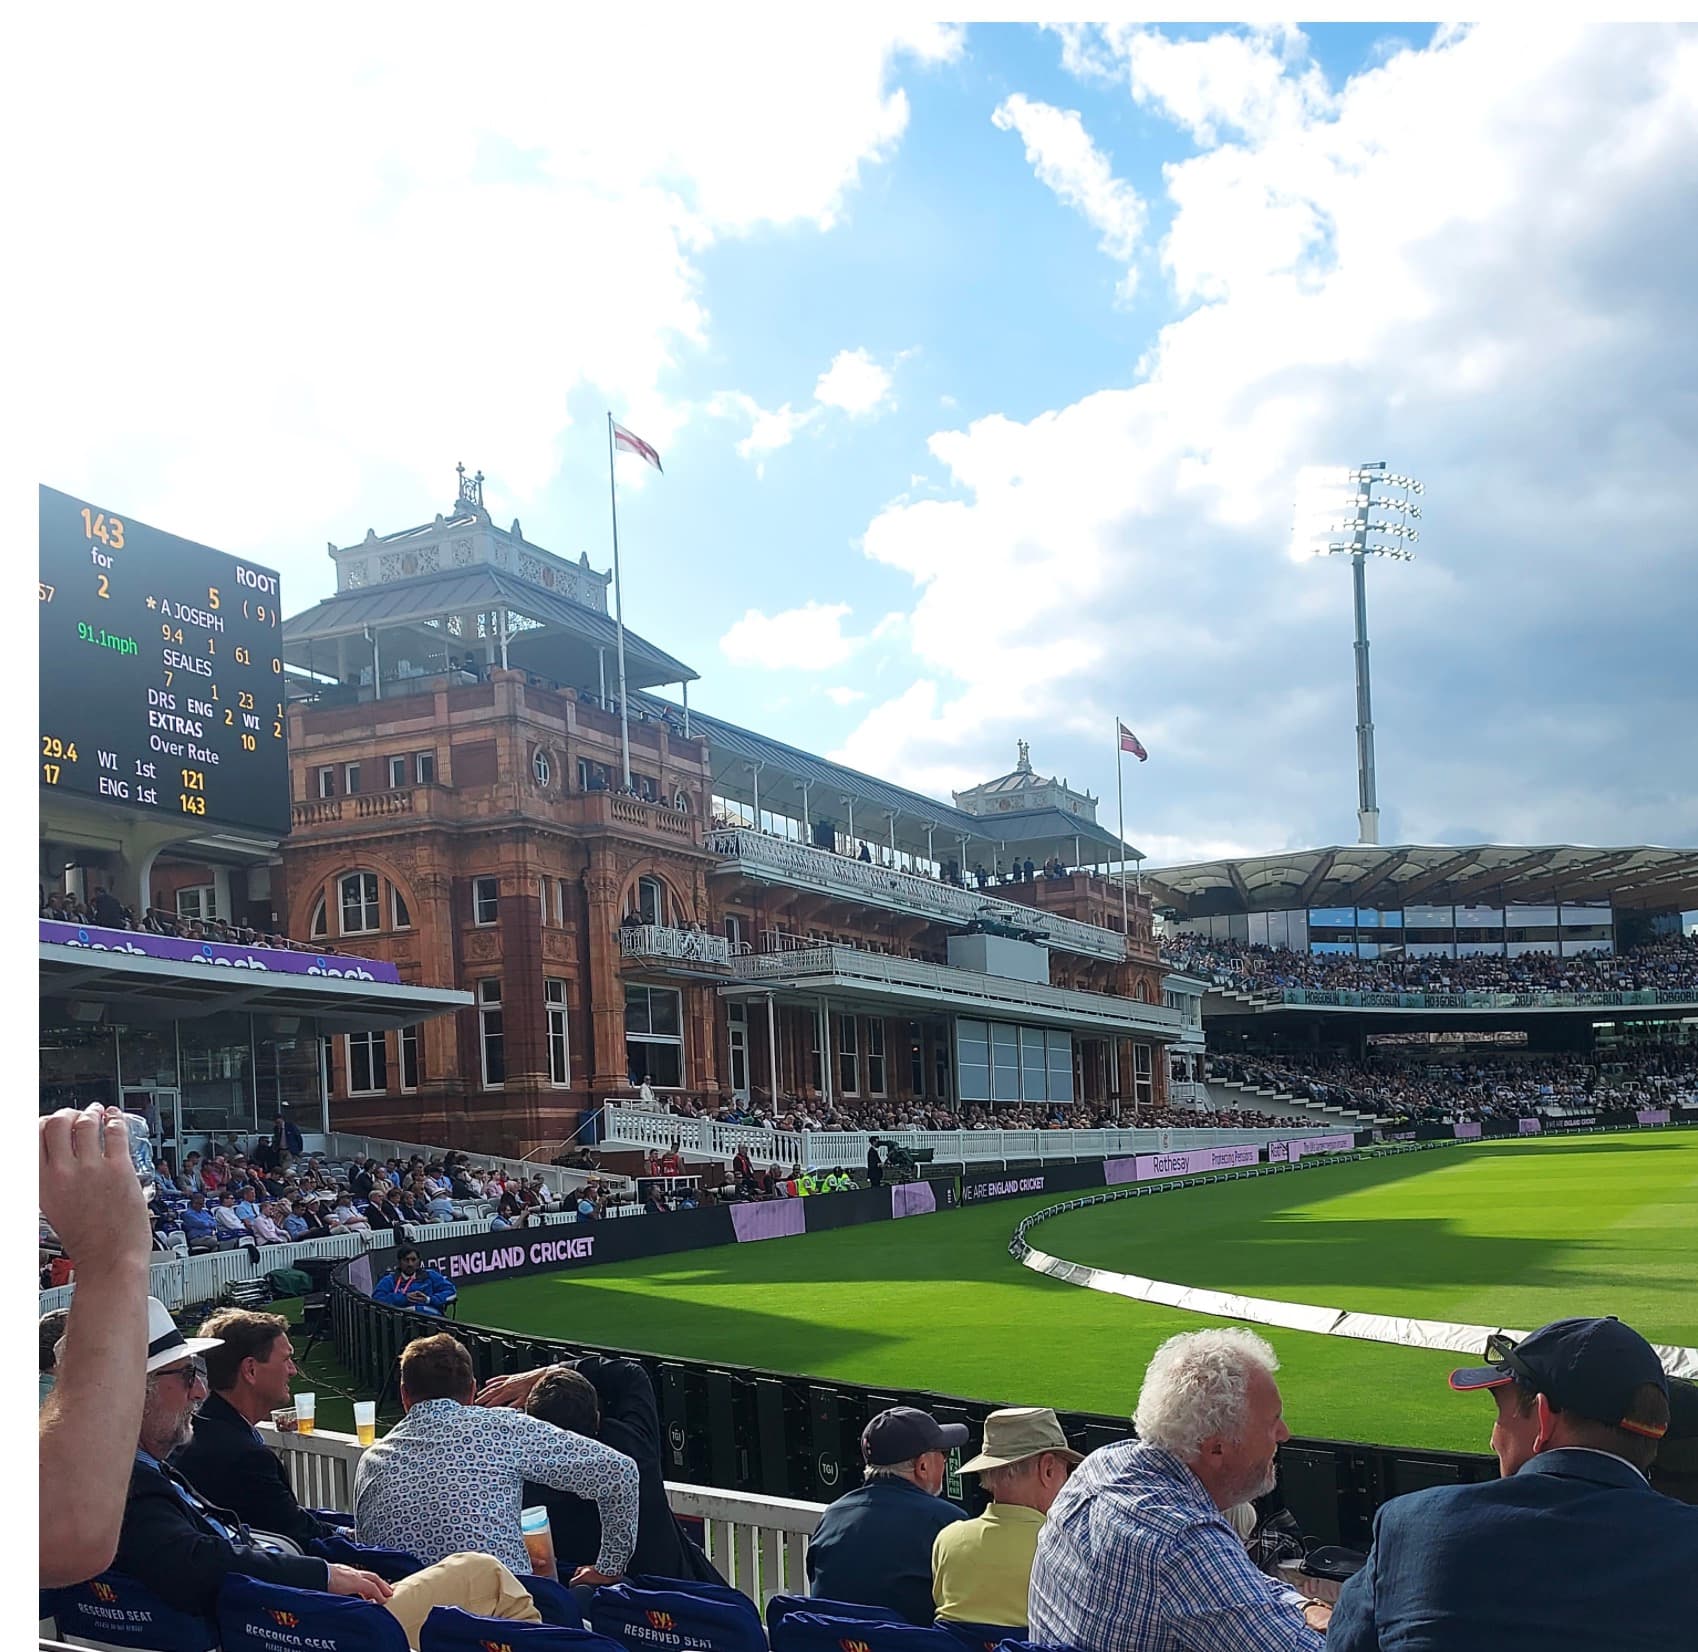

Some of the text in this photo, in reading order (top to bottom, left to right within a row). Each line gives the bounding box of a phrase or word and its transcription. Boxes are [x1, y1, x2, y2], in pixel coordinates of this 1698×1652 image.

[81, 508, 125, 549] 143
[91, 546, 114, 569] for
[97, 574, 110, 599] 2
[236, 566, 277, 595] ROOT
[208, 587, 220, 609] 5
[161, 598, 224, 633] A JOSEPH
[77, 622, 139, 655] 91.1mph
[162, 624, 280, 674] 9.4 1 61 0
[163, 648, 213, 677] SEALES
[164, 670, 283, 718] 7 1 23 1
[148, 688, 282, 738] DRS ENG 2 WI 2
[148, 710, 256, 751] EXTRAS 10
[42, 736, 78, 763] 29.4
[150, 734, 219, 765] Over Rate
[43, 763, 60, 785] 17
[97, 749, 204, 791] WI 1st 121
[99, 776, 206, 815] ENG 1st 143
[1153, 1156, 1190, 1173] Rothesay
[988, 1180, 1018, 1196] ENGLAND
[1019, 1176, 1045, 1192] CRICKET
[450, 1246, 525, 1278] ENGLAND
[529, 1236, 595, 1265] CRICKET
[822, 1463, 834, 1475] TGI
[78, 1602, 153, 1622] RESERVED SEAT
[624, 1623, 681, 1645] RESERVED
